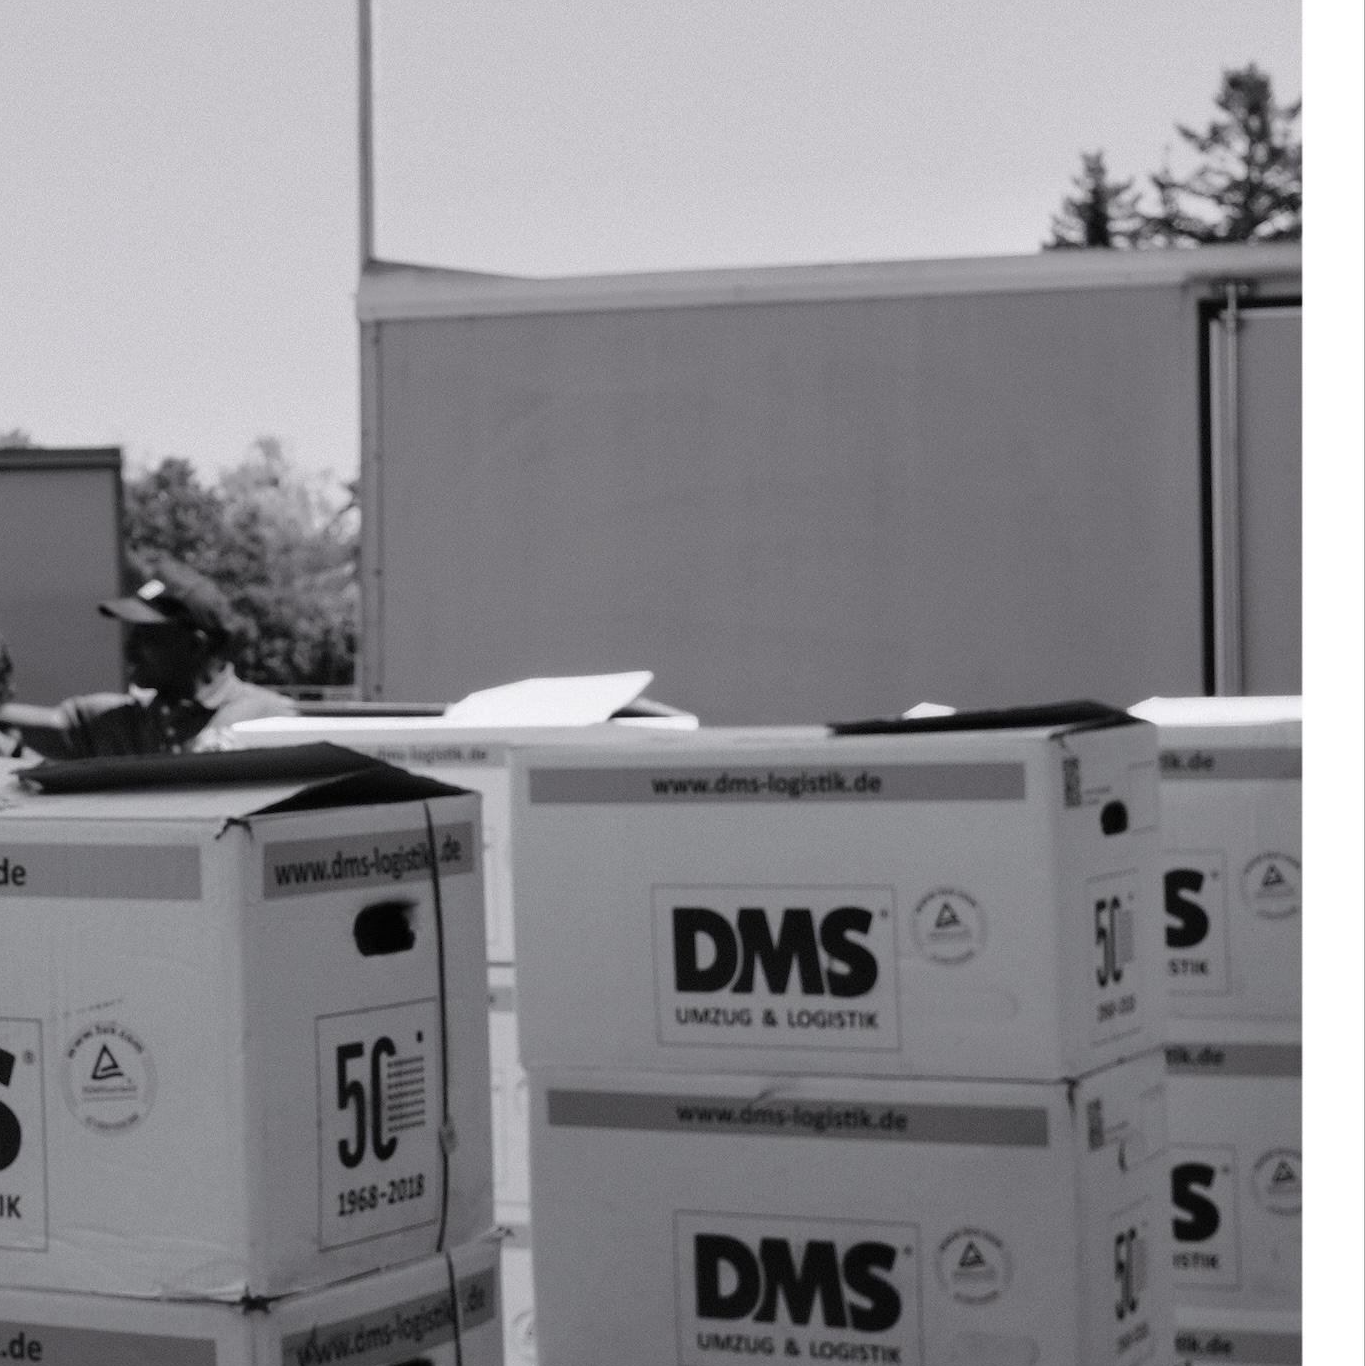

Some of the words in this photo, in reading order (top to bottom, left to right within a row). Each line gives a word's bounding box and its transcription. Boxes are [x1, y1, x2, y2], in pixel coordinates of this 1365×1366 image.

[671, 906, 880, 999] DMS
[676, 1006, 752, 1028] UMZUG
[761, 1007, 778, 1029] &
[788, 1009, 880, 1029] LOGISTIK
[336, 1174, 425, 1217] 1968-2018
[693, 1232, 903, 1333] DMS
[697, 1331, 775, 1358] UMZUG
[784, 1337, 800, 1358] &
[810, 1338, 903, 1366] LOGISTIK
